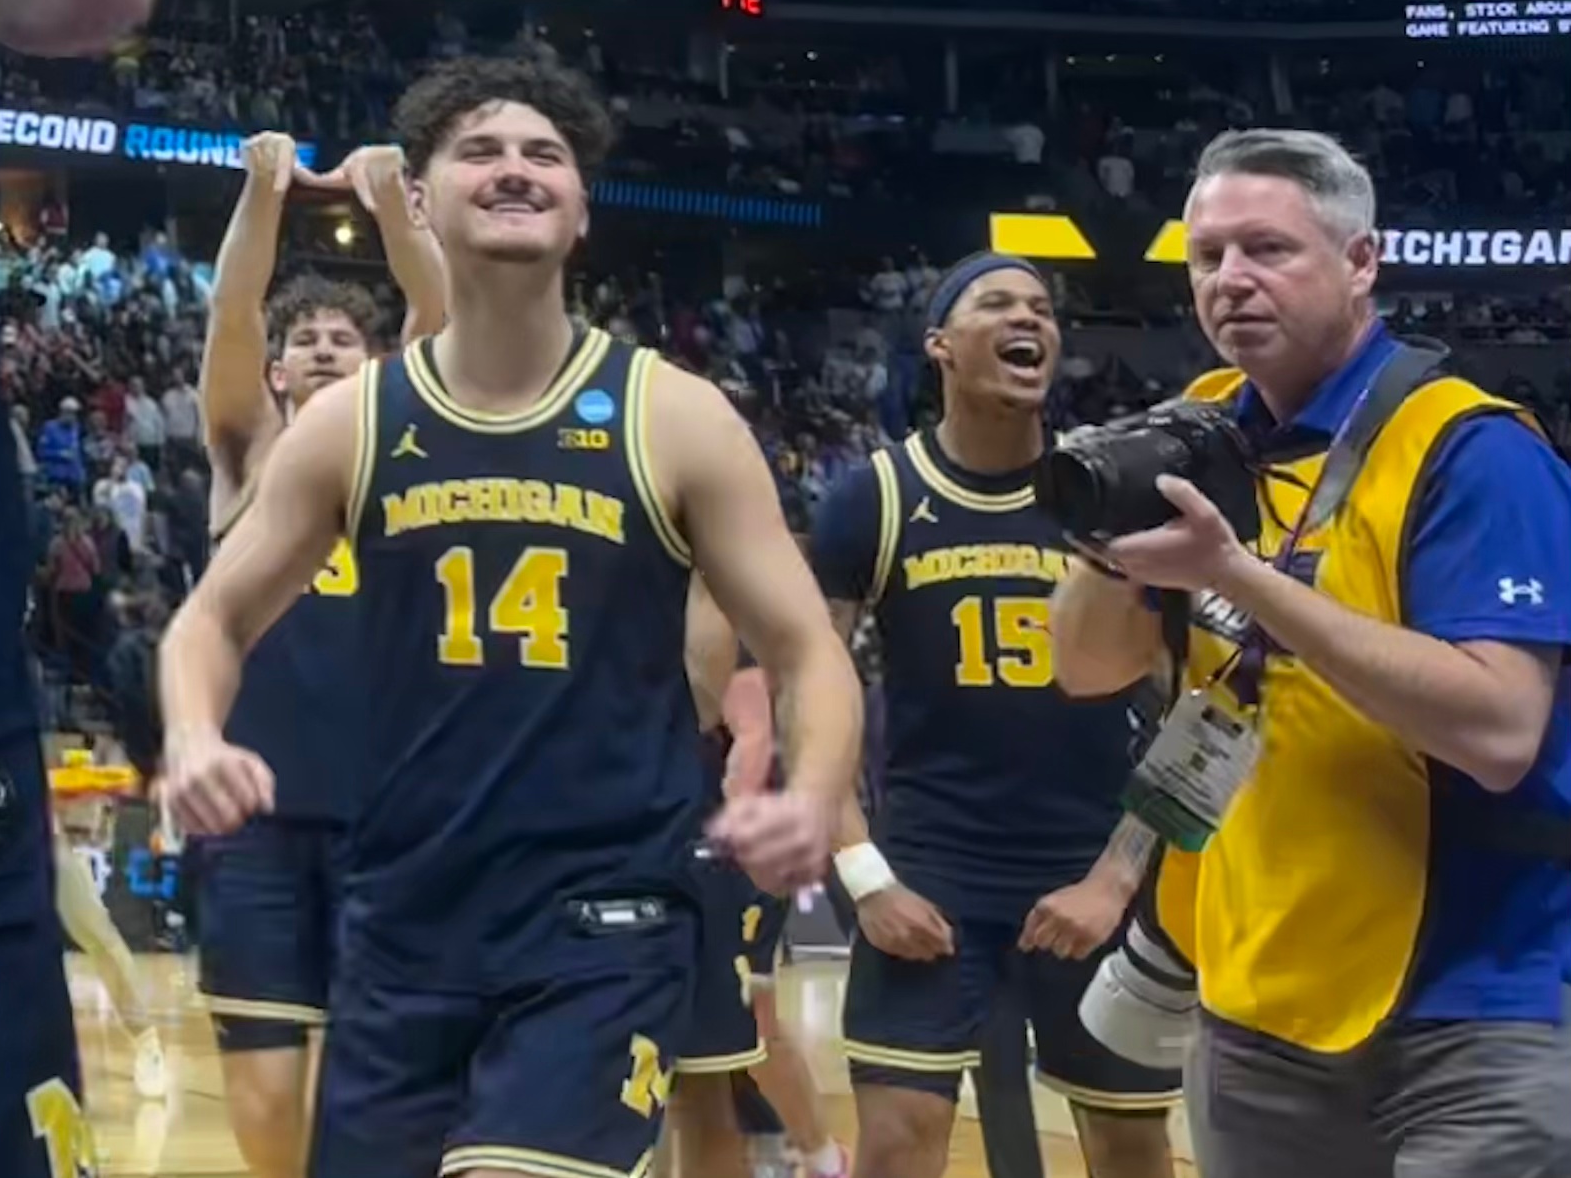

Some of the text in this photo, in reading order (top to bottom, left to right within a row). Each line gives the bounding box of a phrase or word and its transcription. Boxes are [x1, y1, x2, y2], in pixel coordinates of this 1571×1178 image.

[1405, 4, 1455, 20] FANS,
[1464, 2, 1517, 18] STICK
[1405, 22, 1449, 38] GAME
[1456, 19, 1550, 36] FEATURING
[124, 123, 248, 168] ROUN
[381, 477, 627, 545] MICHIGAN
[902, 542, 1071, 591] MICHIGA
[435, 545, 569, 669] 14
[951, 594, 1057, 687] 15
